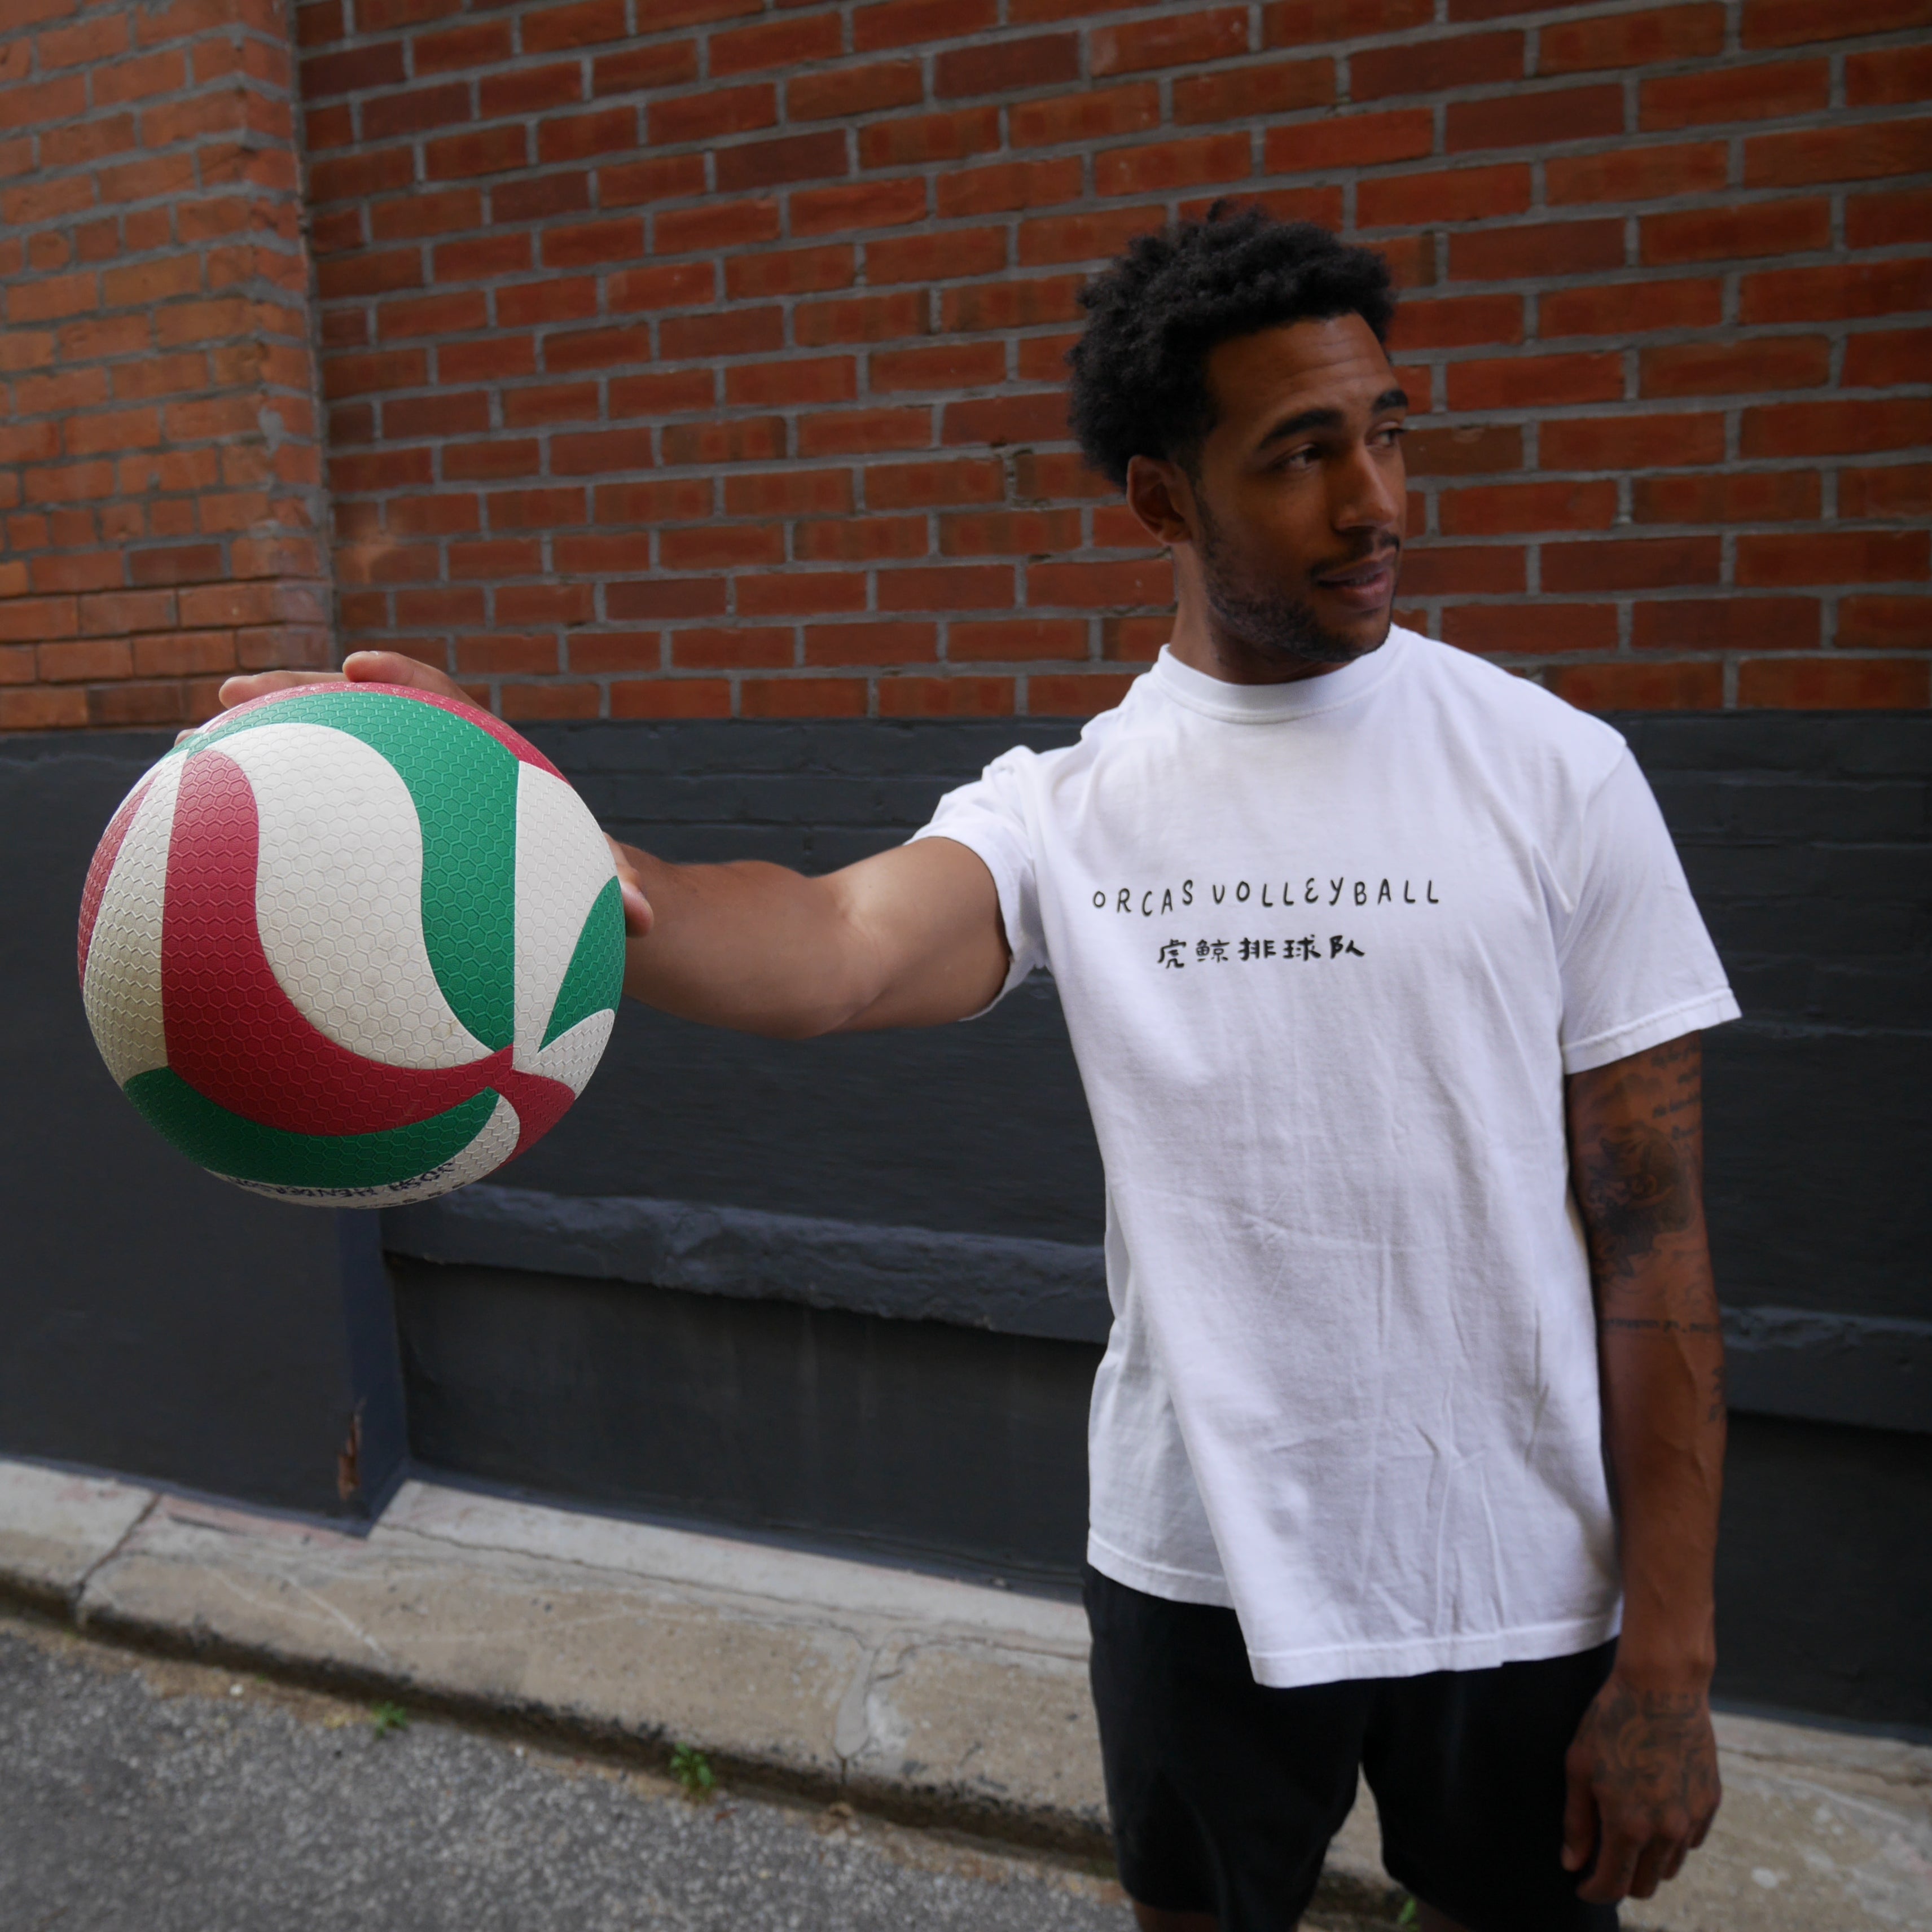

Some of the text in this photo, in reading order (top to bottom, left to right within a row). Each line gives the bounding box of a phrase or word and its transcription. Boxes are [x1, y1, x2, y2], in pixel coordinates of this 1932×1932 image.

[1094, 877, 1438, 916] ORCAS VOLLEYBALL
[1158, 934, 1364, 968] 虎鲸排球队
